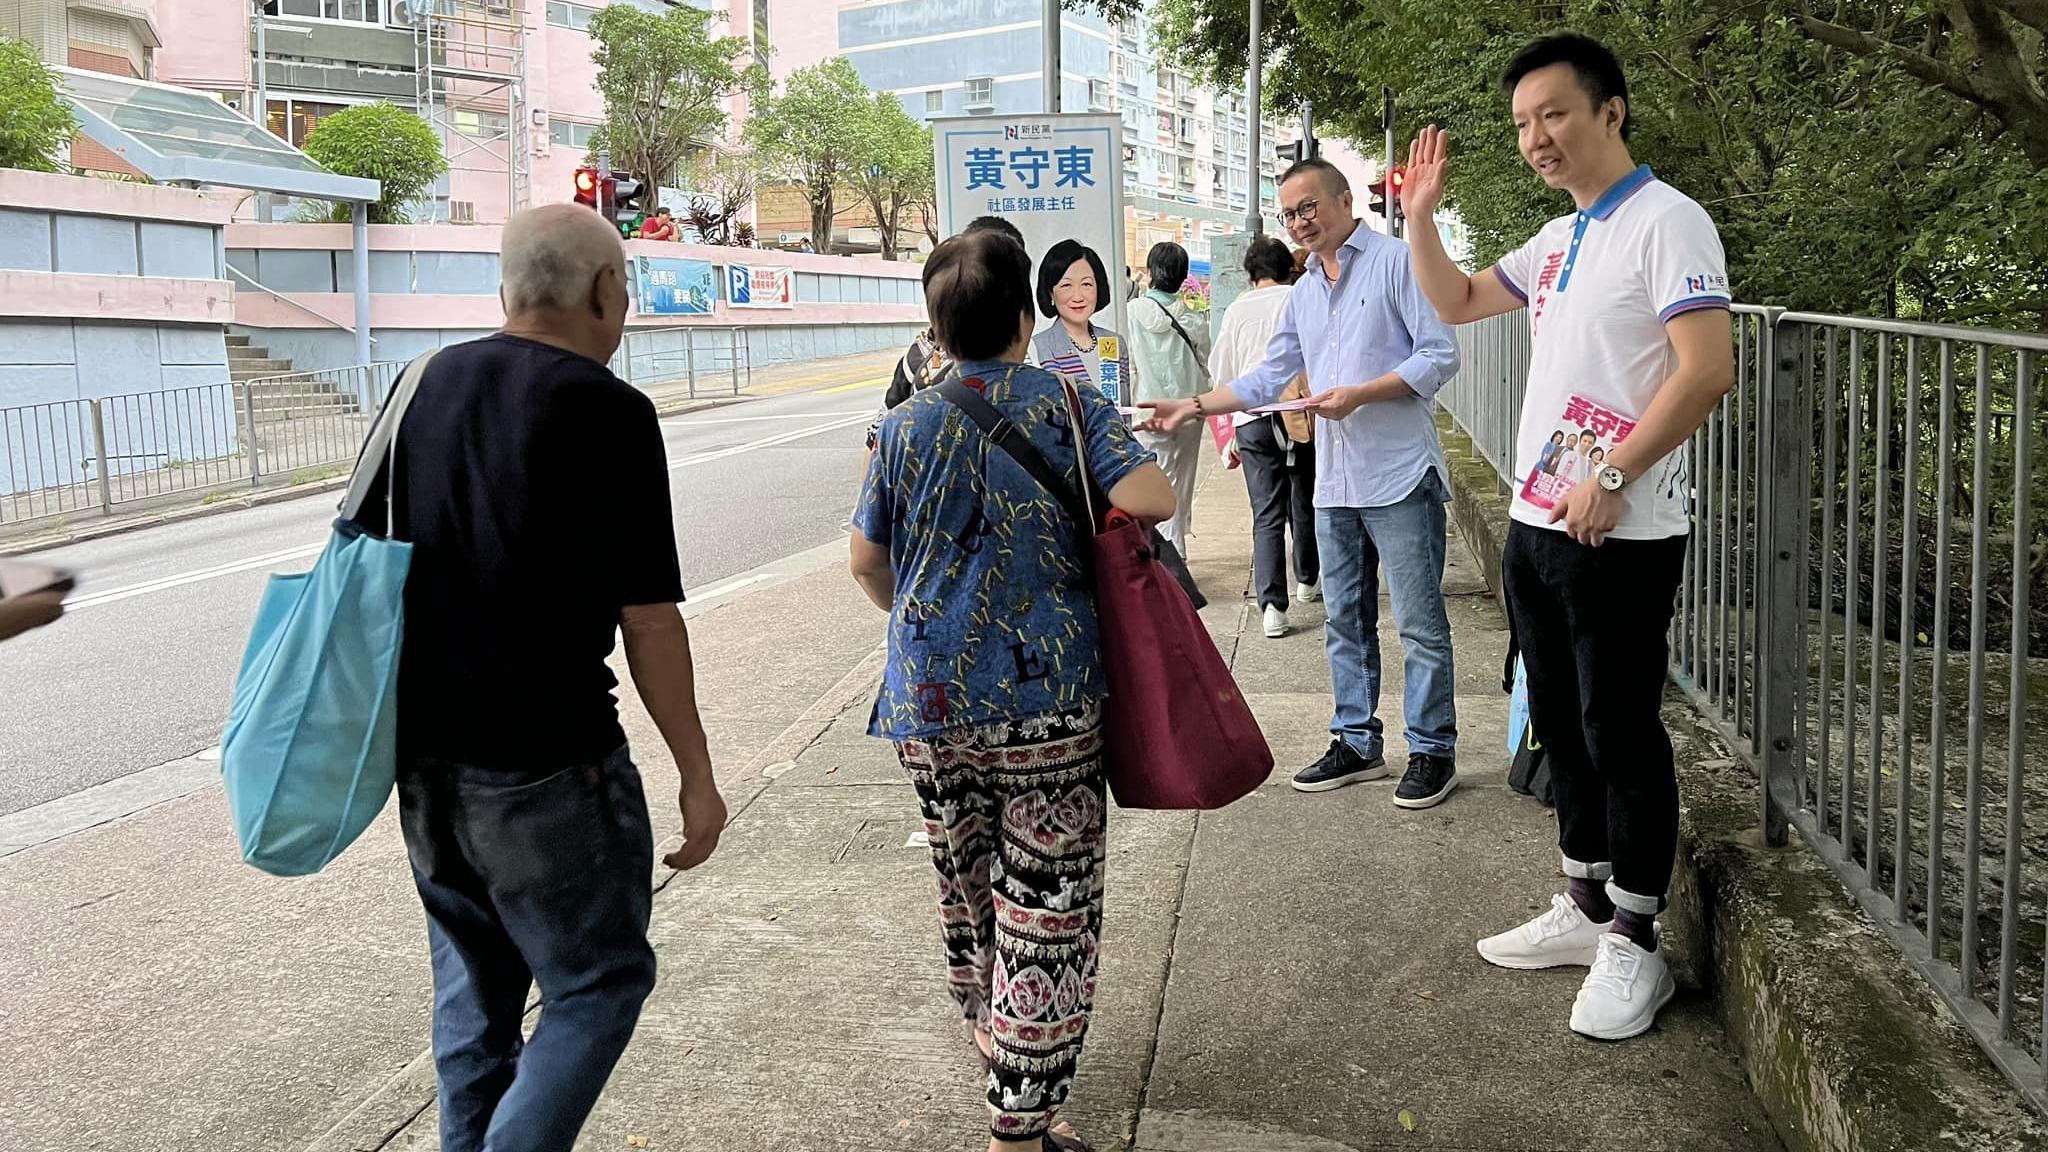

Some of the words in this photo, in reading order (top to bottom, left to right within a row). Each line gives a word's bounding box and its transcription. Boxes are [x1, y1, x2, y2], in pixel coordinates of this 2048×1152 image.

[1021, 124, 1051, 135] 新民黨
[964, 145, 1096, 191] 黃守東
[987, 196, 1076, 213] 社區發展主任
